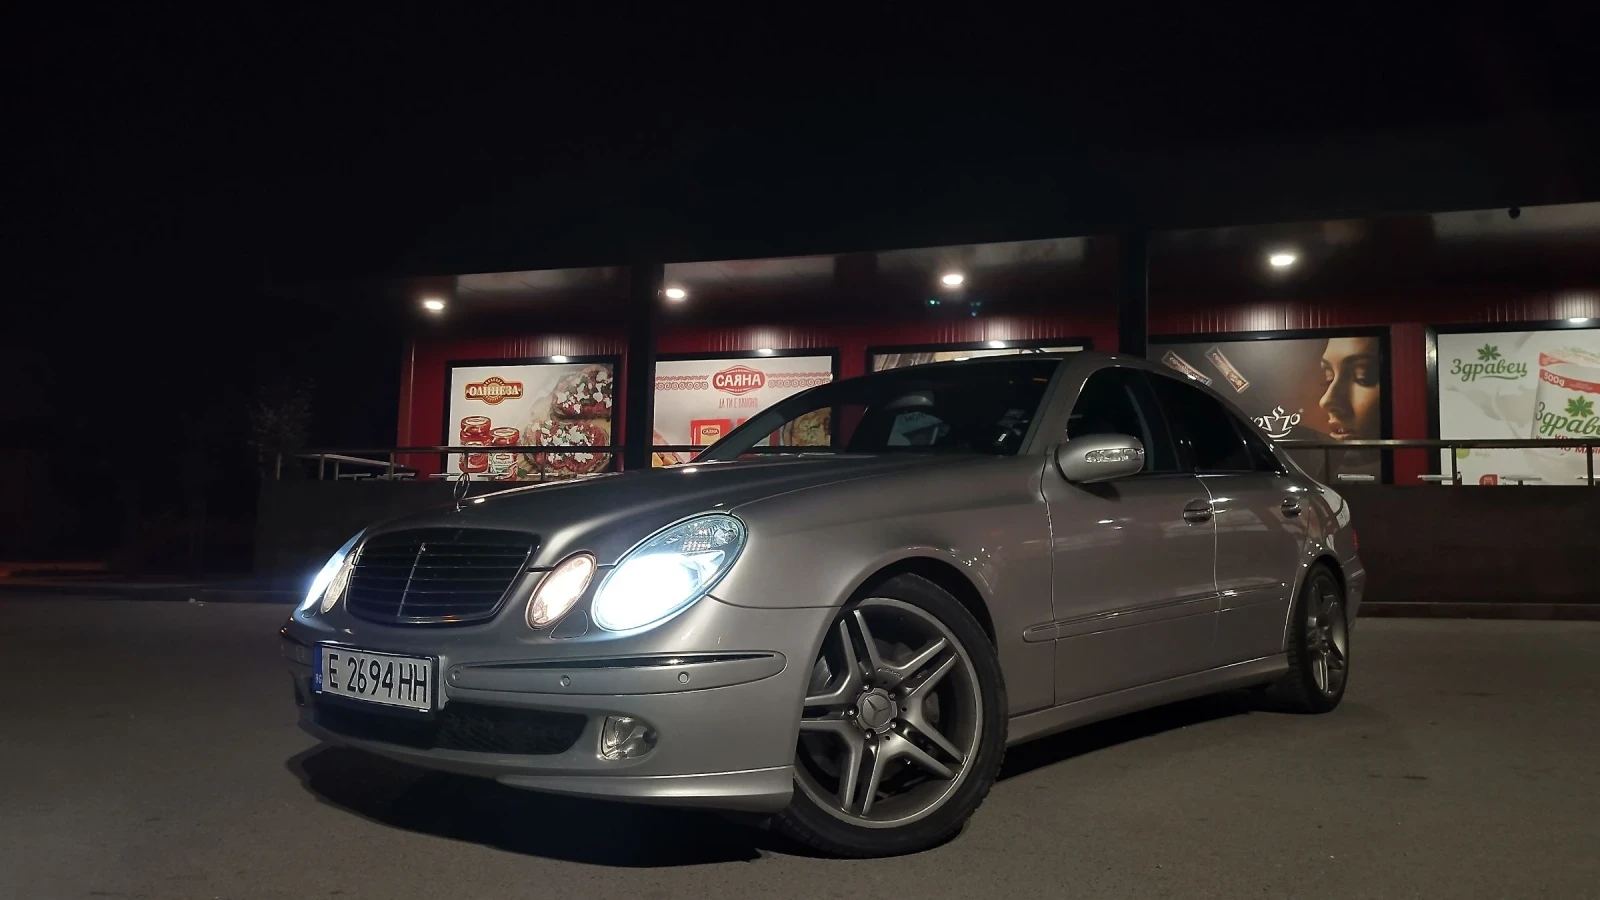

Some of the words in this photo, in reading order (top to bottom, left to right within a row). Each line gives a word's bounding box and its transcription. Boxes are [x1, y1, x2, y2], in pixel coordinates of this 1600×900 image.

[1450, 358, 1528, 382] Здравец
[1544, 371, 1565, 387] 500g
[715, 373, 762, 388] САЯНА
[329, 653, 339, 689] E
[347, 656, 394, 698] 2694
[398, 662, 427, 703] HH
